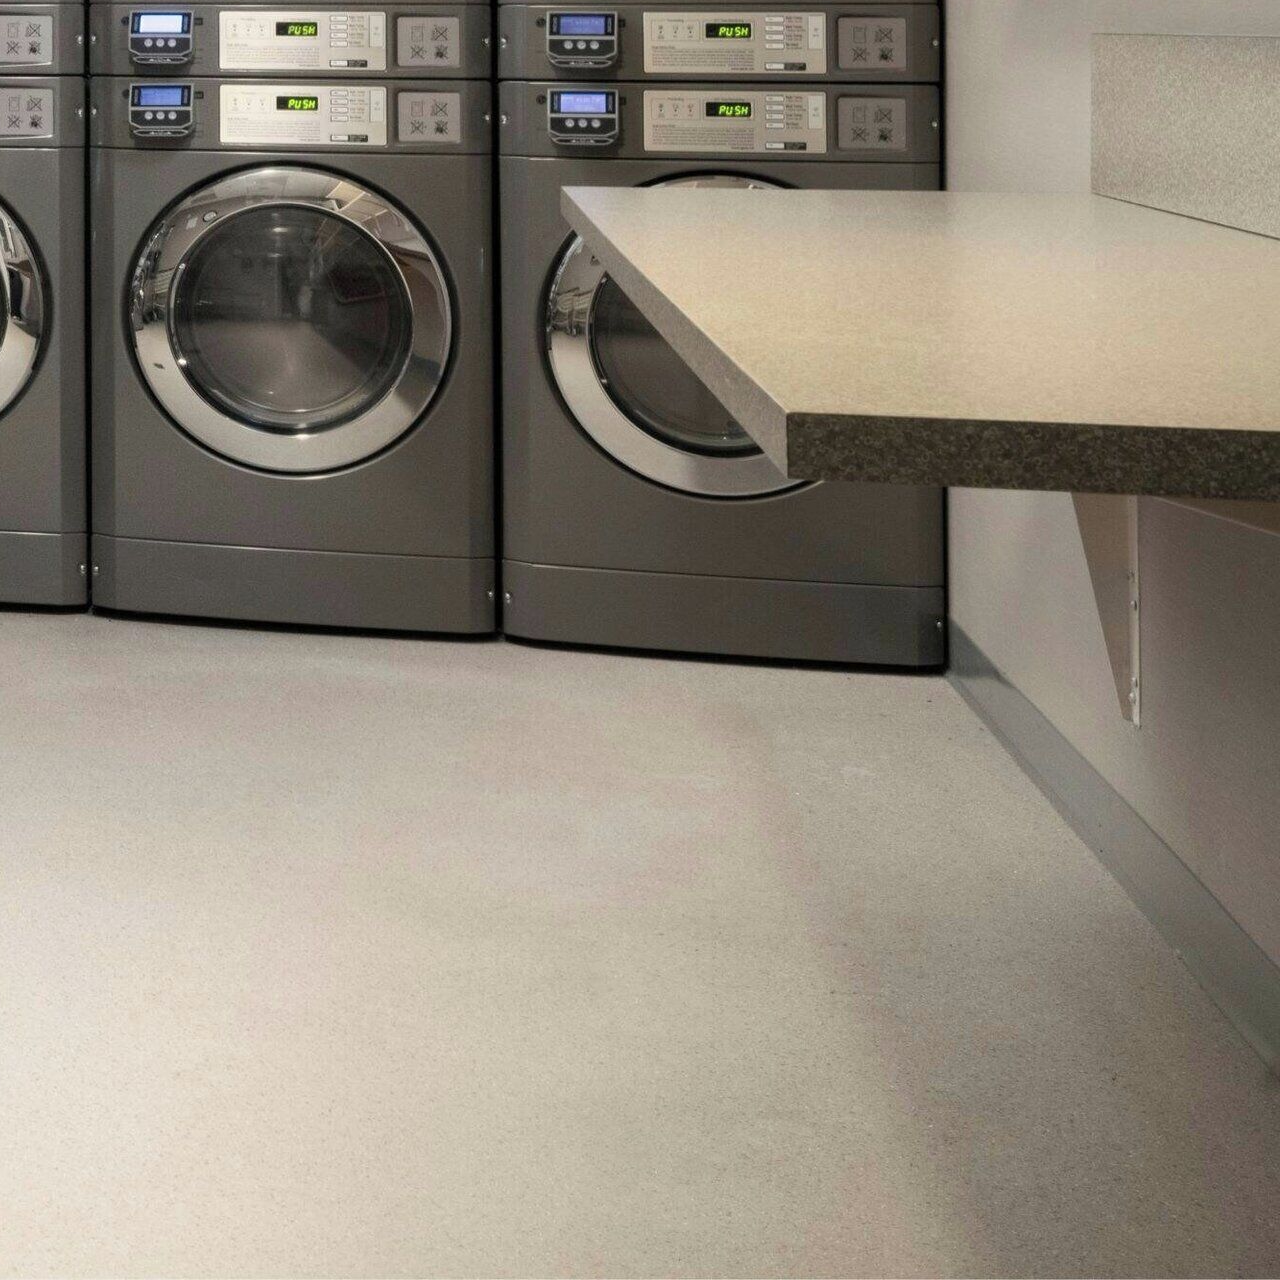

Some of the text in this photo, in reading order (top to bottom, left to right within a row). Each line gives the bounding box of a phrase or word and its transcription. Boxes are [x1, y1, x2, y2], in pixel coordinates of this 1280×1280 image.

[288, 25, 316, 36] PUSH
[719, 26, 749, 37] PUSH
[288, 99, 316, 110] PUSH
[719, 105, 749, 115] PUSH
